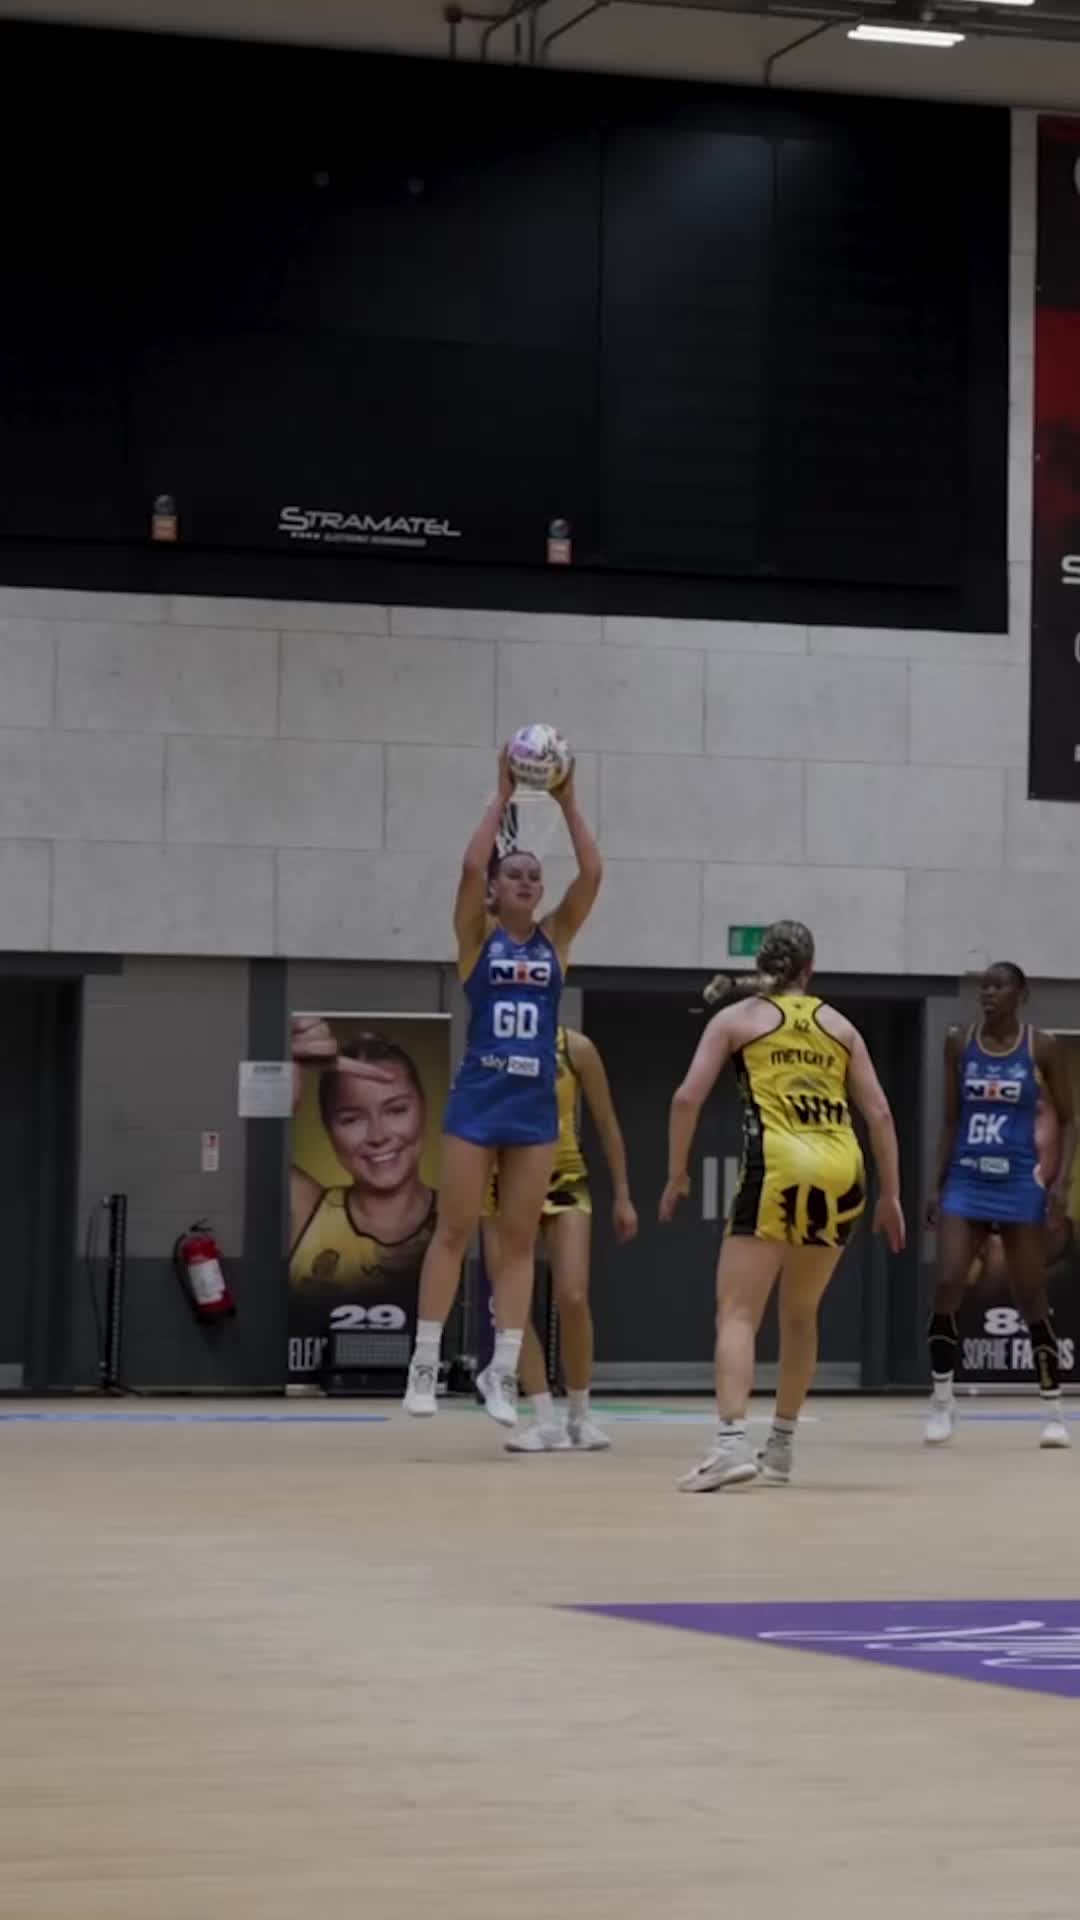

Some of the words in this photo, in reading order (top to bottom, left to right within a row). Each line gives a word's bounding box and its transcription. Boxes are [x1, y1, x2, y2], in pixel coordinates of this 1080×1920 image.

[279, 505, 462, 537] STRAMATEL
[493, 1000, 538, 1039] GD
[785, 1095, 843, 1125] WH
[967, 1112, 1008, 1144] GK
[330, 1303, 406, 1330] 29
